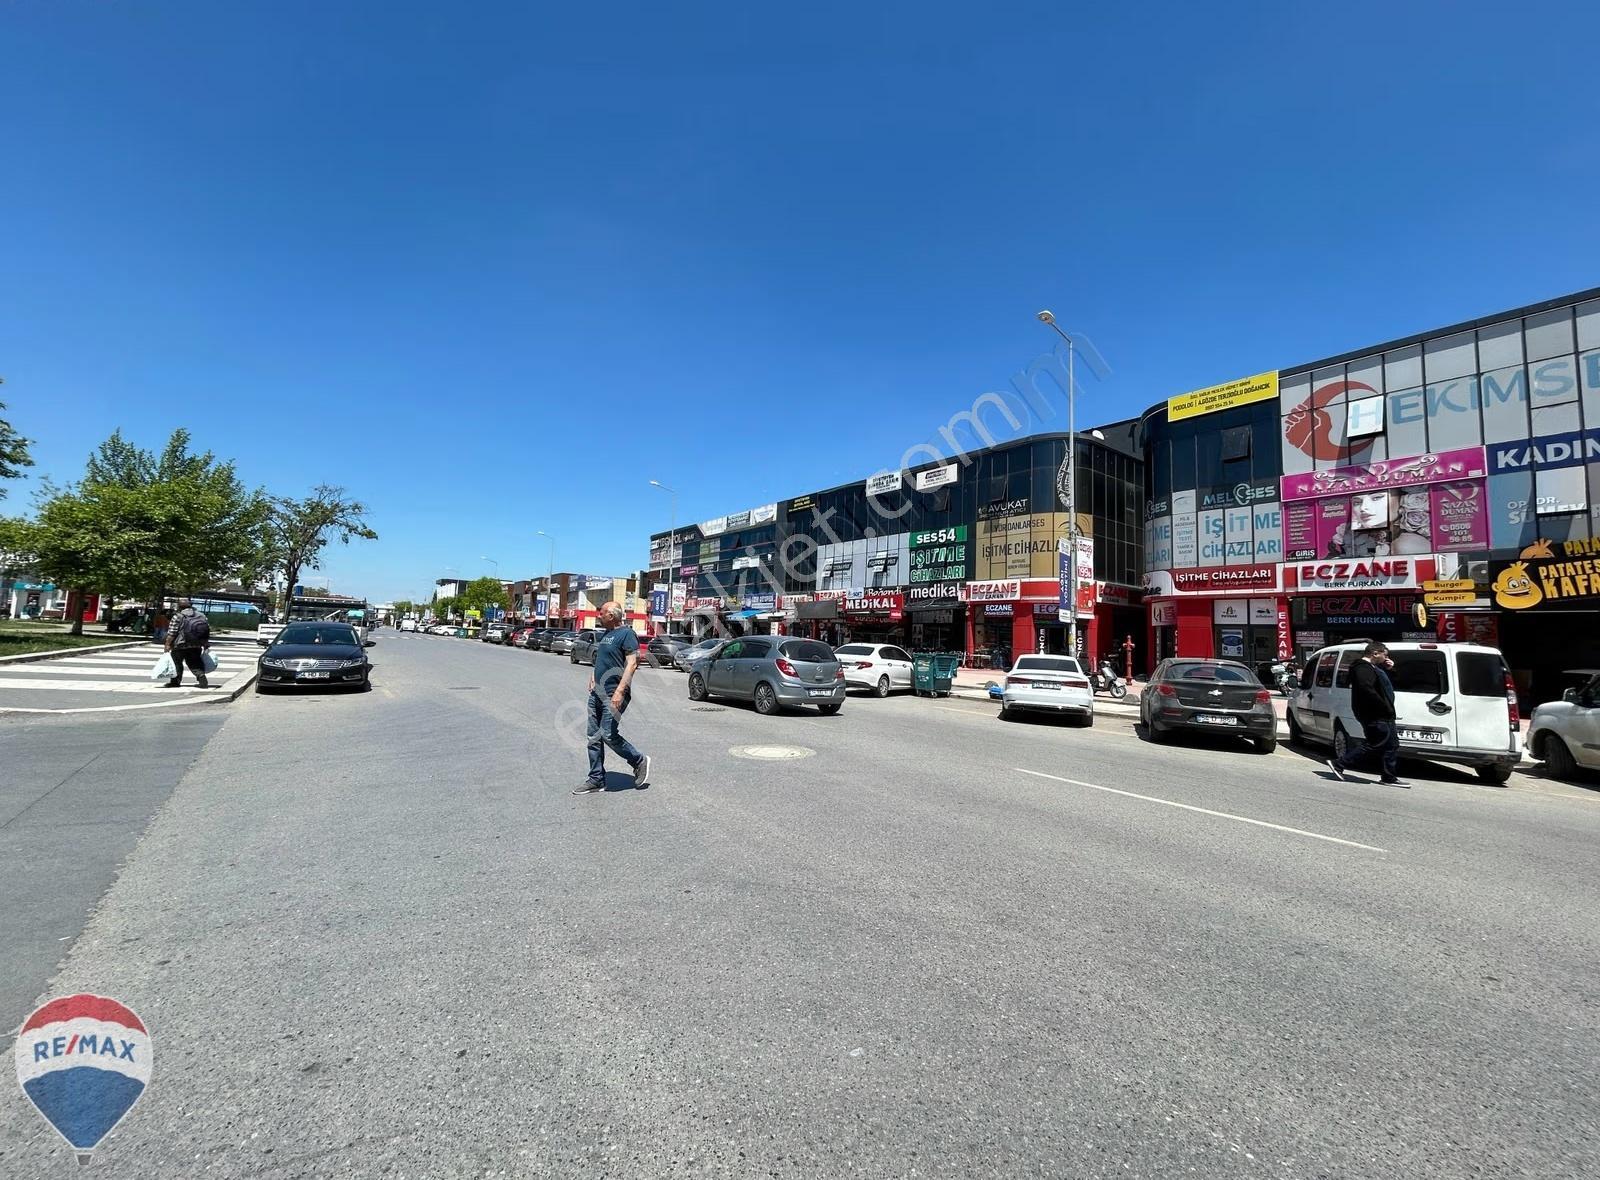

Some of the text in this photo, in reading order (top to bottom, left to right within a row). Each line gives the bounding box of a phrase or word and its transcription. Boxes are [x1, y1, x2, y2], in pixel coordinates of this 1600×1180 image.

[988, 498, 1028, 513] AVUKAT
[1204, 511, 1281, 539] İŞİTME
[916, 529, 956, 544] SES54
[982, 543, 1012, 562] İŞİTME
[1202, 538, 1282, 560] CİHAZLARI
[1175, 568, 1272, 584] İŞİTME CİHAZLARI
[1302, 560, 1409, 581] ECZANE
[1538, 559, 1600, 580] PATATES
[910, 582, 960, 599] medikal
[972, 582, 1018, 595] ECZANE
[1324, 580, 1383, 589] BERK FURKAN
[1433, 581, 1464, 589] Burger
[1433, 594, 1466, 602] Kumpir
[985, 604, 1013, 612] ECZANE
[1327, 616, 1395, 624] BERK FURKAN
